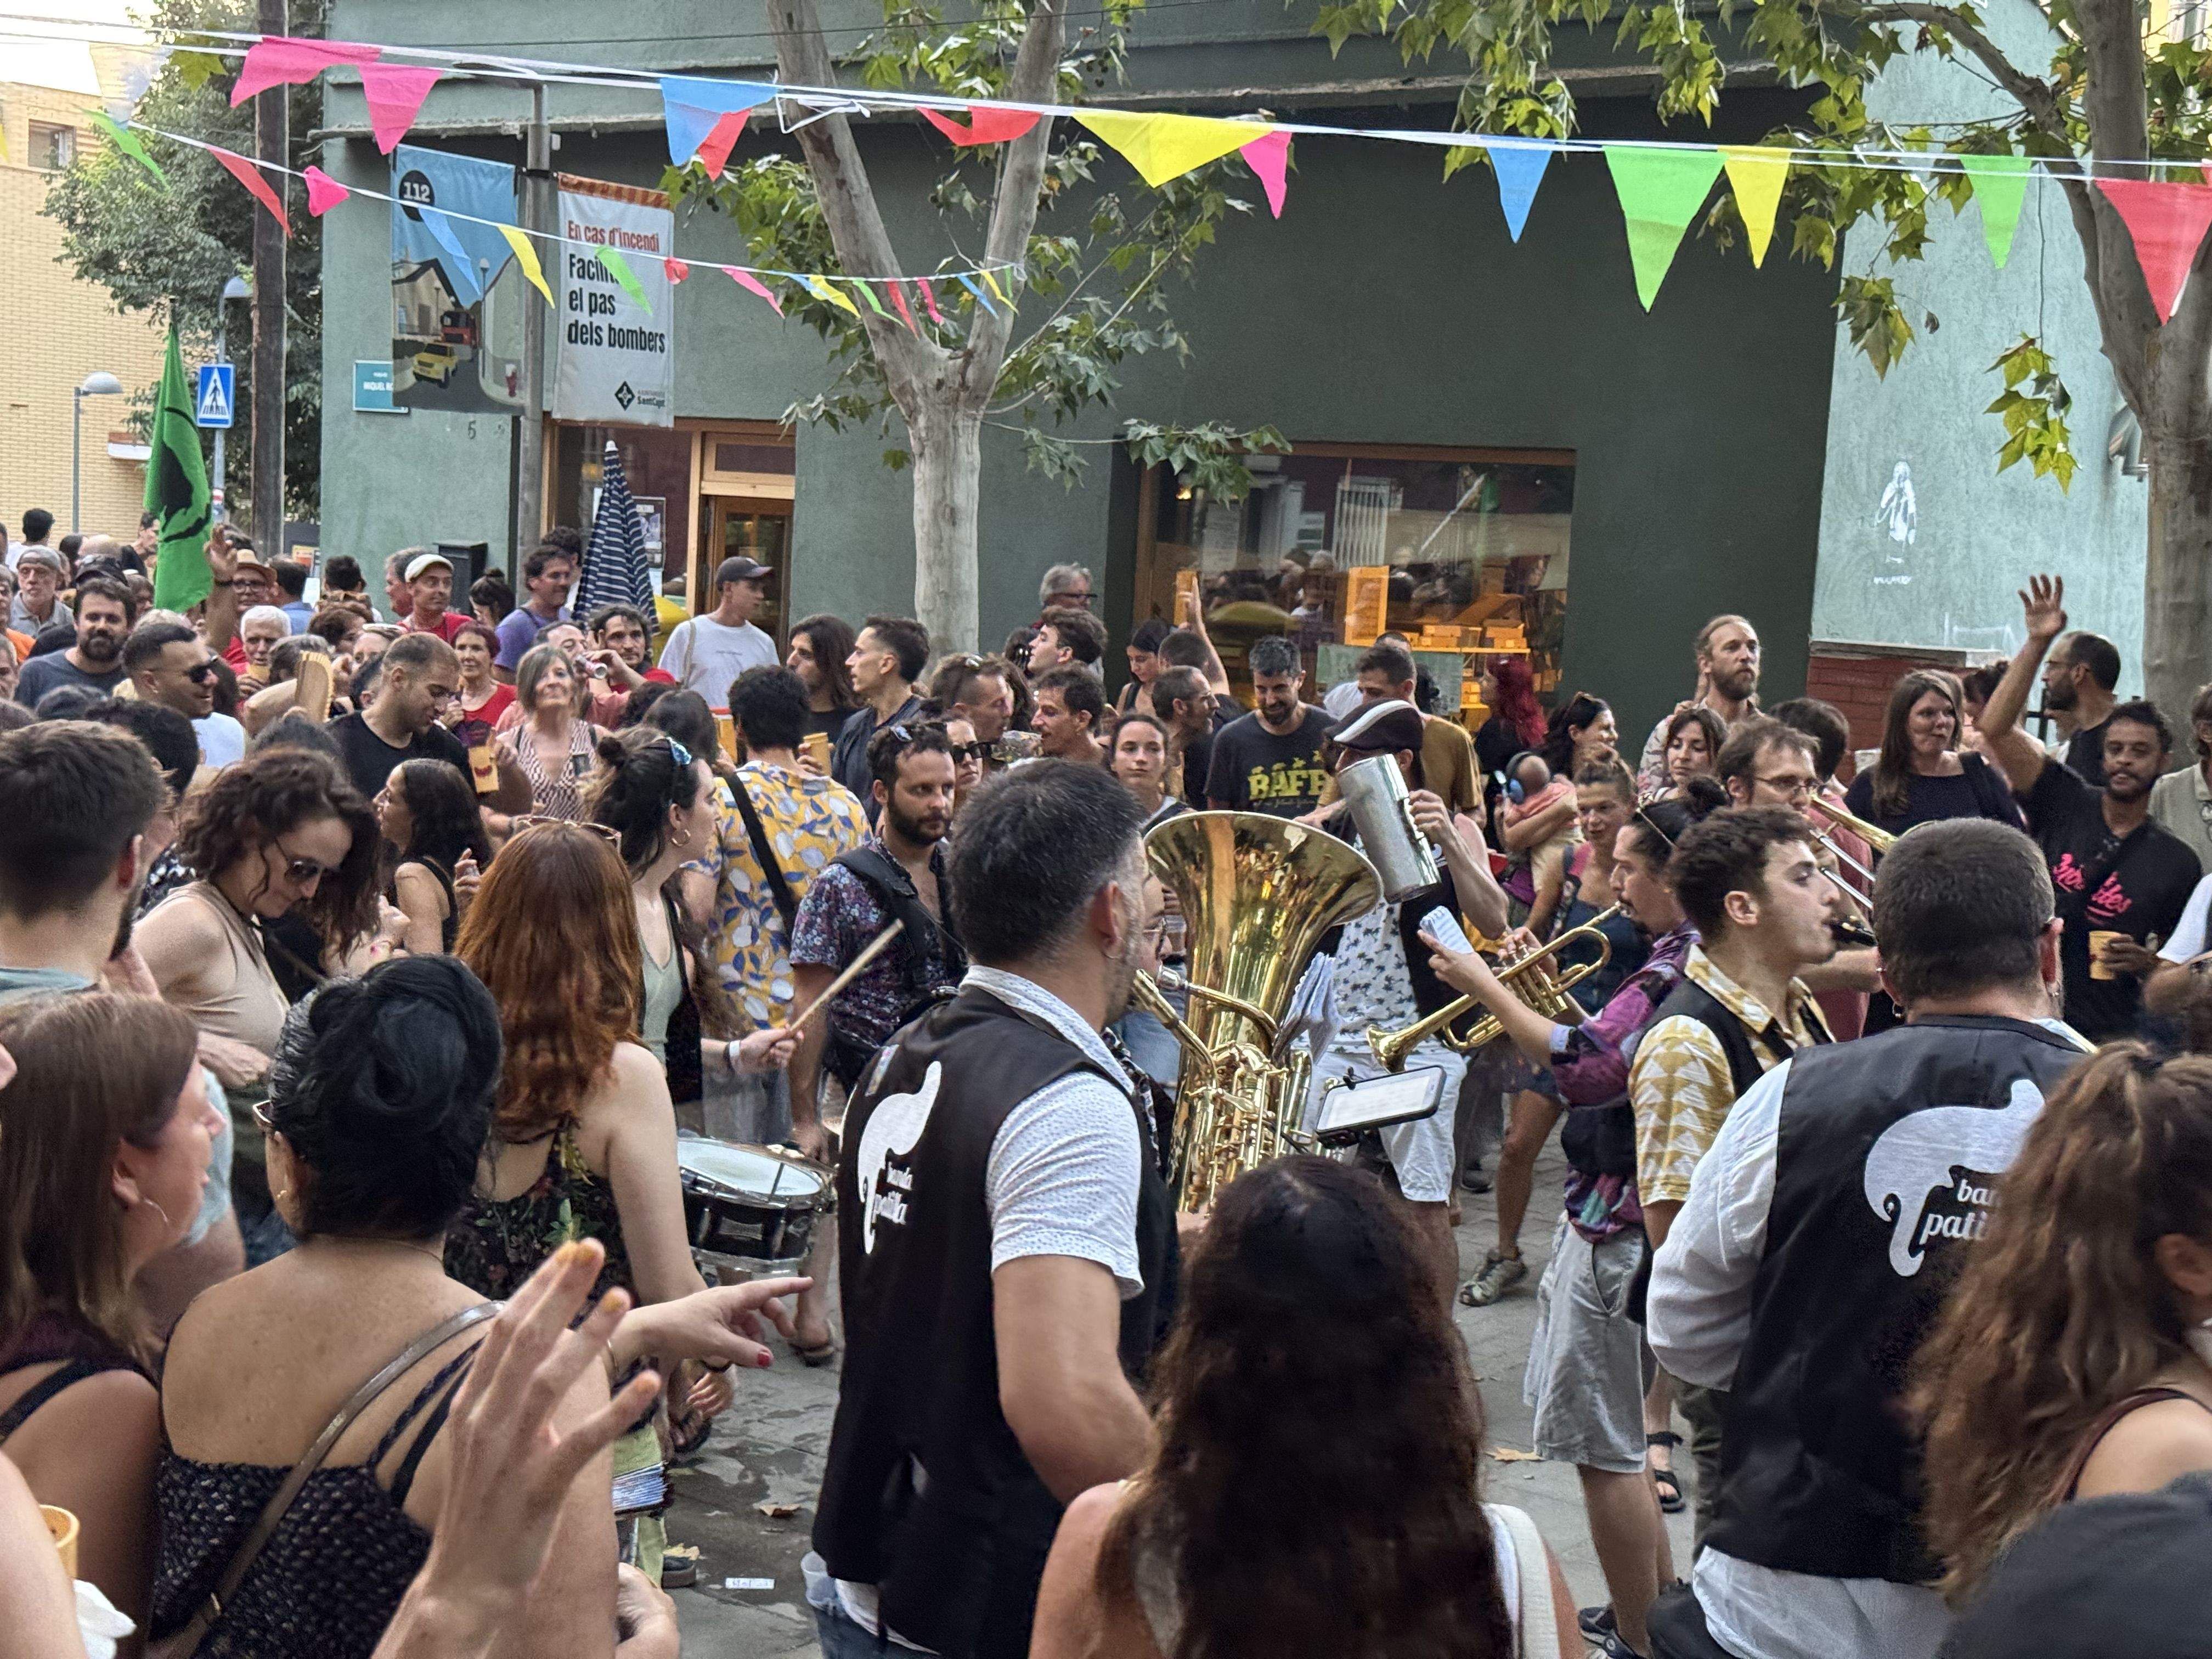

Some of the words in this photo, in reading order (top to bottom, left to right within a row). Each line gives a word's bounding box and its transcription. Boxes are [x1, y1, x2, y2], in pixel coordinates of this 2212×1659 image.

[403, 182, 430, 202] 112
[568, 220, 582, 240] En
[584, 225, 606, 244] cas
[608, 227, 659, 253] d'incendi
[569, 253, 619, 285] Facili
[569, 287, 583, 312] el
[589, 291, 616, 317] pas
[568, 319, 603, 347] dels
[608, 323, 665, 354] bombers
